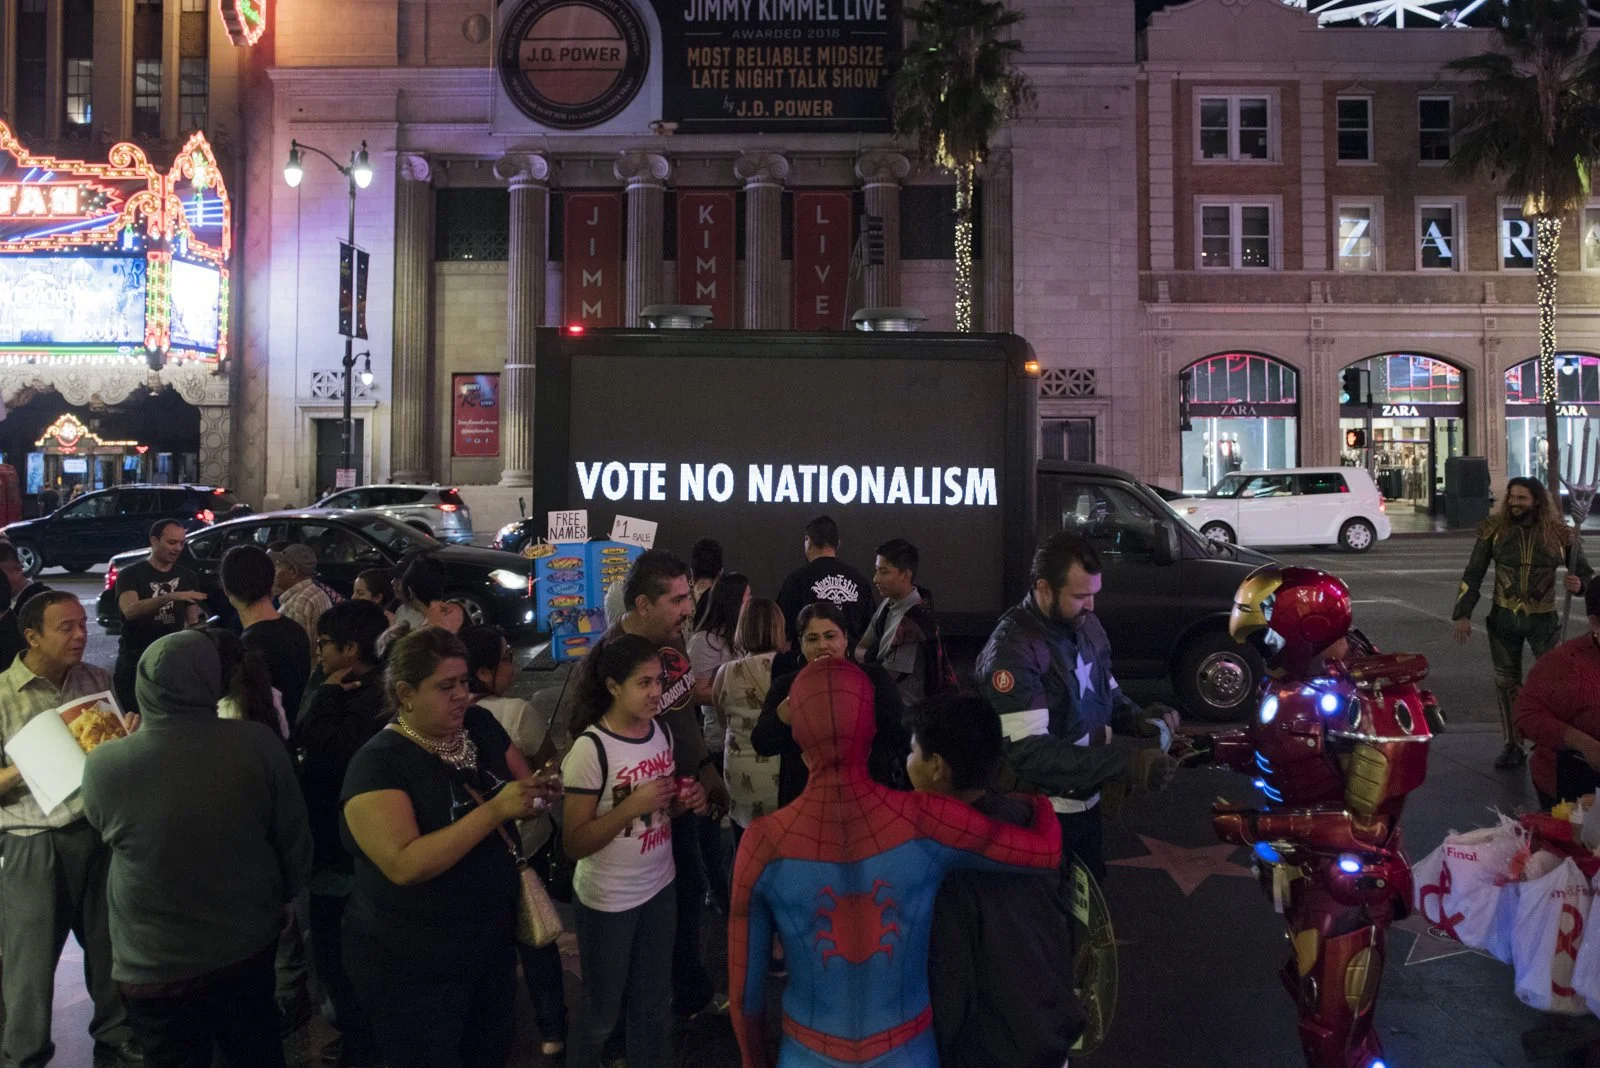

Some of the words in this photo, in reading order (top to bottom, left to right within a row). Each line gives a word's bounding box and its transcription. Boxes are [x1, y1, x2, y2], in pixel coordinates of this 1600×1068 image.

[684, 0, 751, 22] JIMMY
[759, 0, 839, 21] KIMMEL
[843, 0, 887, 21] LIVE
[732, 29, 802, 39] AWARDED
[807, 28, 840, 39] 2018
[526, 47, 556, 62] J.D.
[559, 47, 621, 62] POWER
[687, 47, 732, 67] MOST
[736, 47, 812, 67] RELIABLE
[818, 46, 884, 66] MIDSIZE
[691, 69, 730, 89] LATE
[735, 69, 785, 89] NIGHT
[788, 69, 828, 89] TALK
[721, 94, 735, 114] by
[736, 100, 770, 117] J.D.
[774, 100, 834, 117] POWER
[696, 205, 718, 311] KIMM
[815, 205, 832, 315] LIVE
[1220, 404, 1257, 416] ZARA
[1382, 405, 1419, 417] ZARA
[575, 461, 666, 501] VOTE
[680, 463, 734, 503] NO
[748, 465, 998, 506] NATIONALISM
[556, 512, 580, 526] FREE
[549, 526, 586, 540] NAMES
[632, 533, 651, 543] SALE
